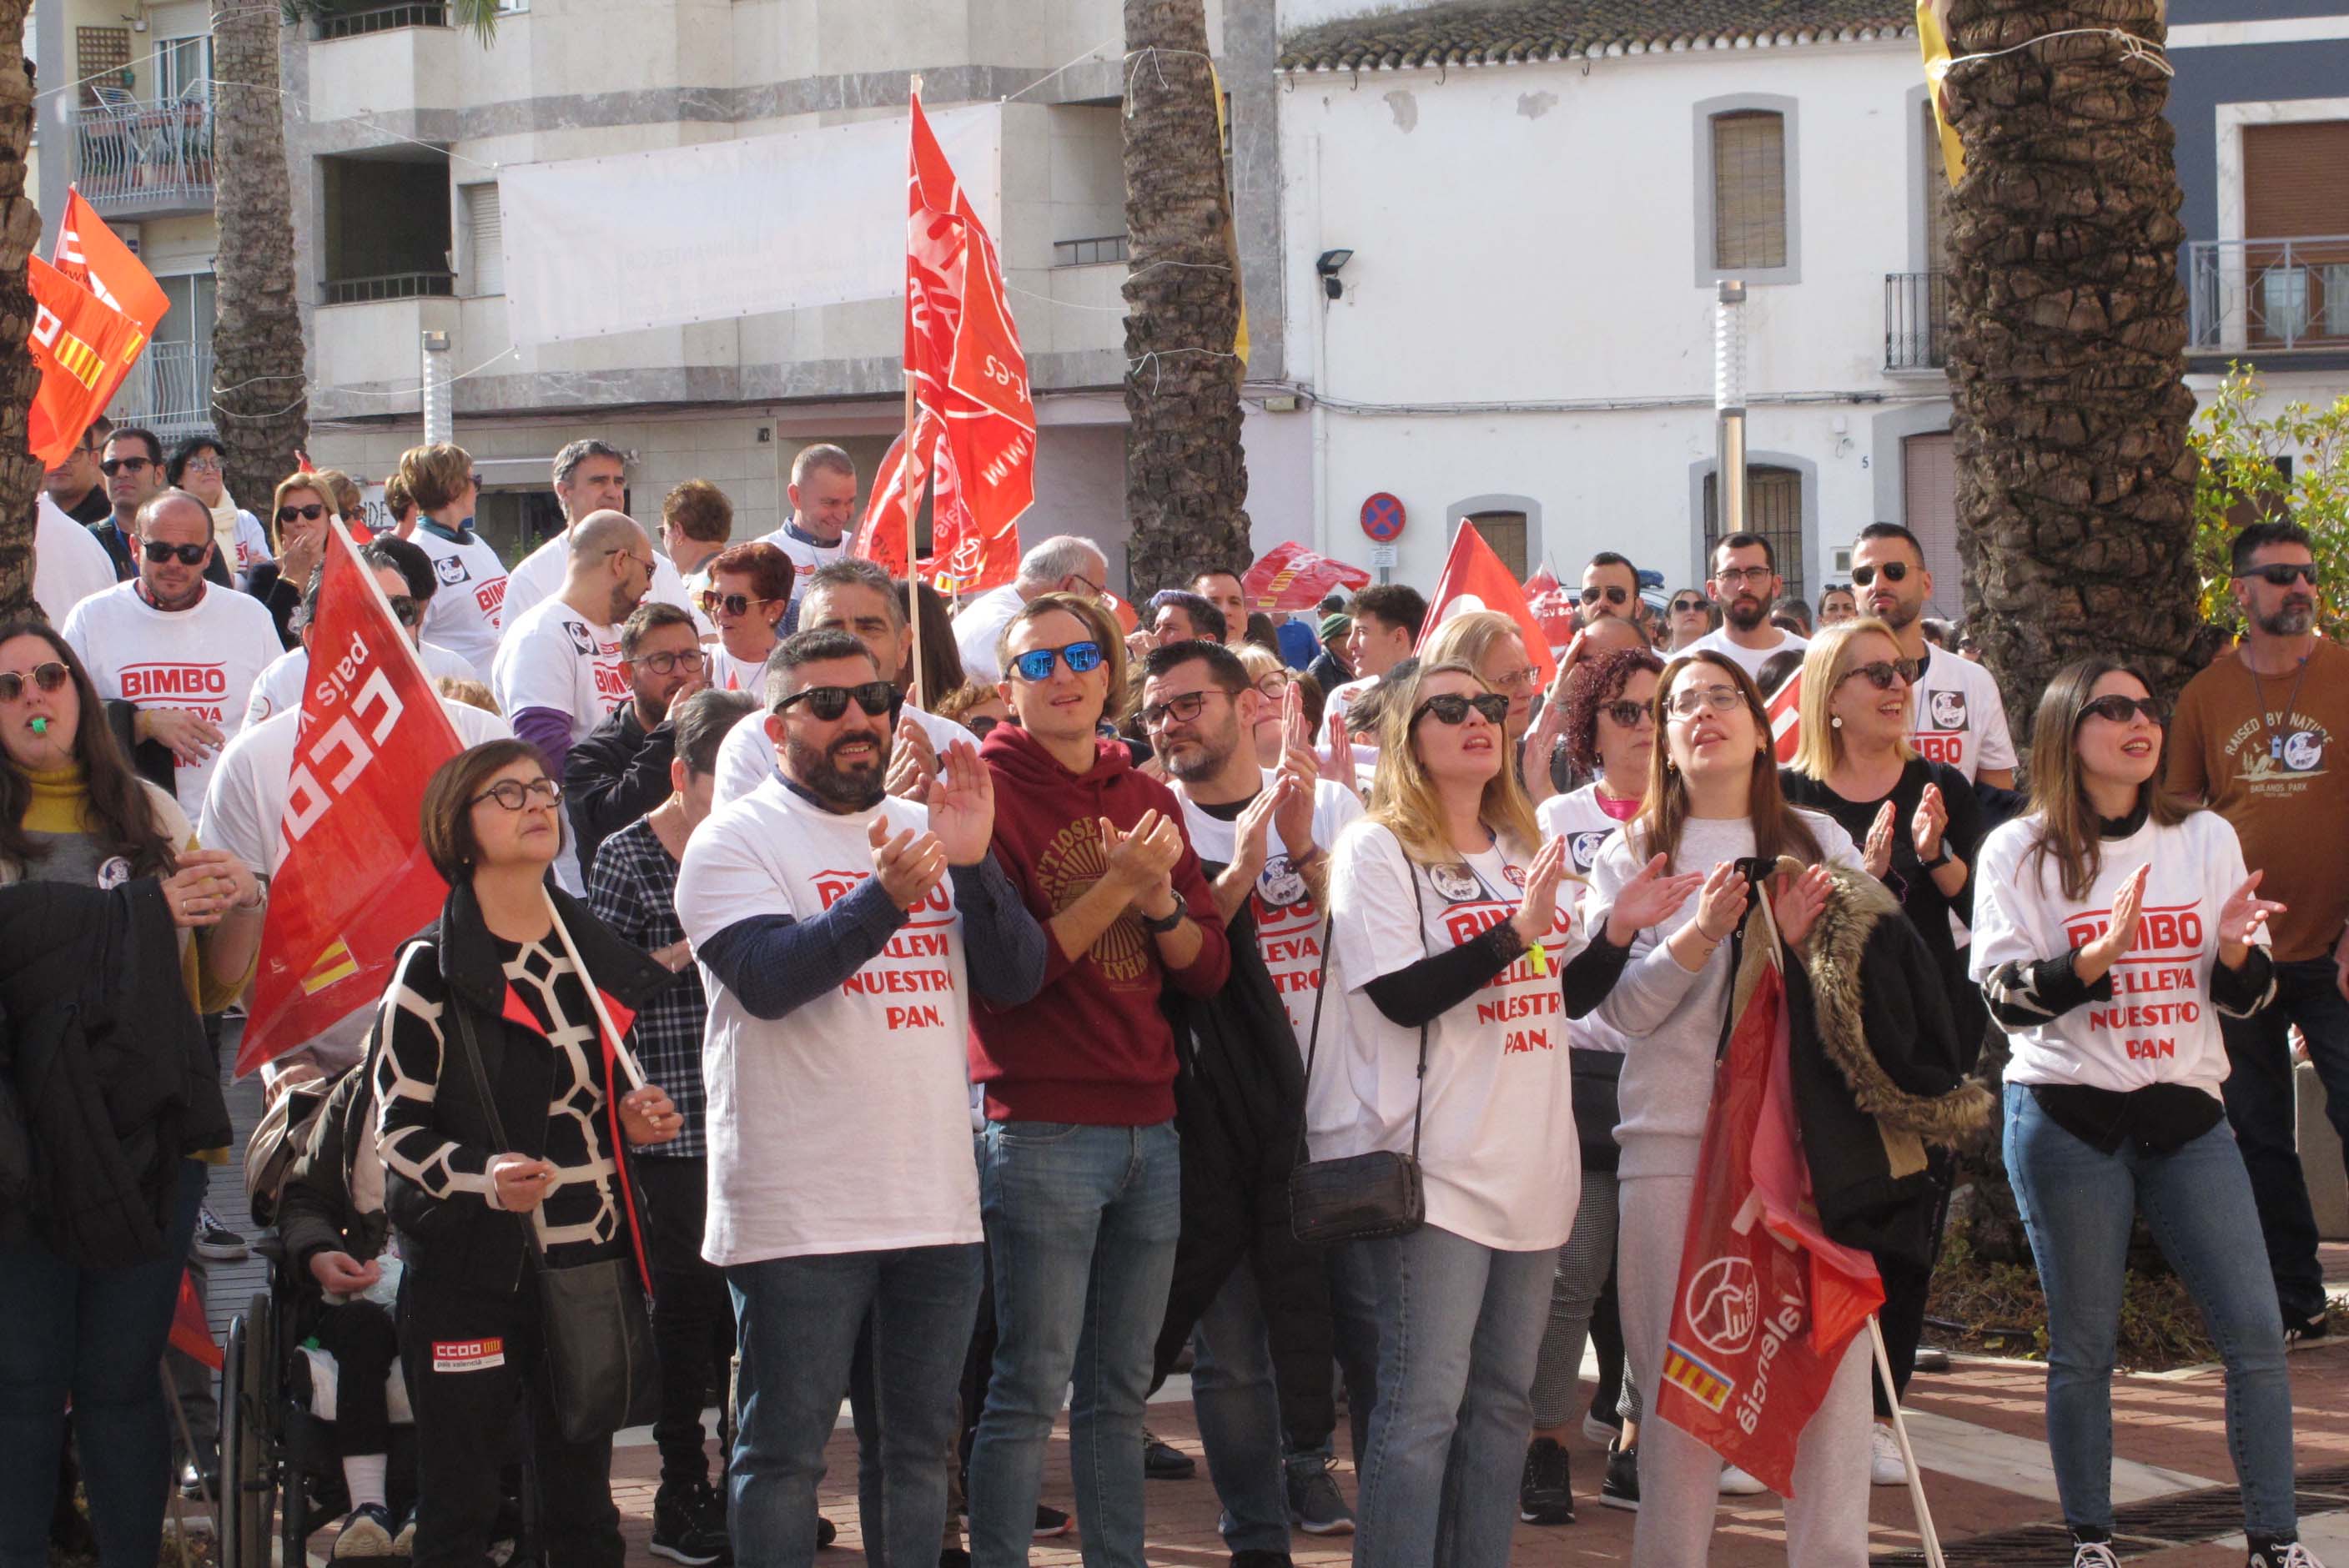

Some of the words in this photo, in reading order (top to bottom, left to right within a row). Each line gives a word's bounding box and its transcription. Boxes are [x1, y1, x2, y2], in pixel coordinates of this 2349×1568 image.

[1862, 455, 1869, 469] 5
[120, 669, 227, 698] BIMBO
[2225, 717, 2261, 756] RAISED
[2266, 711, 2283, 727] BY
[1050, 817, 1099, 857] LOSE
[842, 969, 955, 997] NUESTR
[2125, 967, 2196, 994] LLEVA
[886, 1004, 945, 1030] PAN.
[1504, 1028, 1554, 1055] PAN.
[436, 1344, 482, 1357] CCOO
